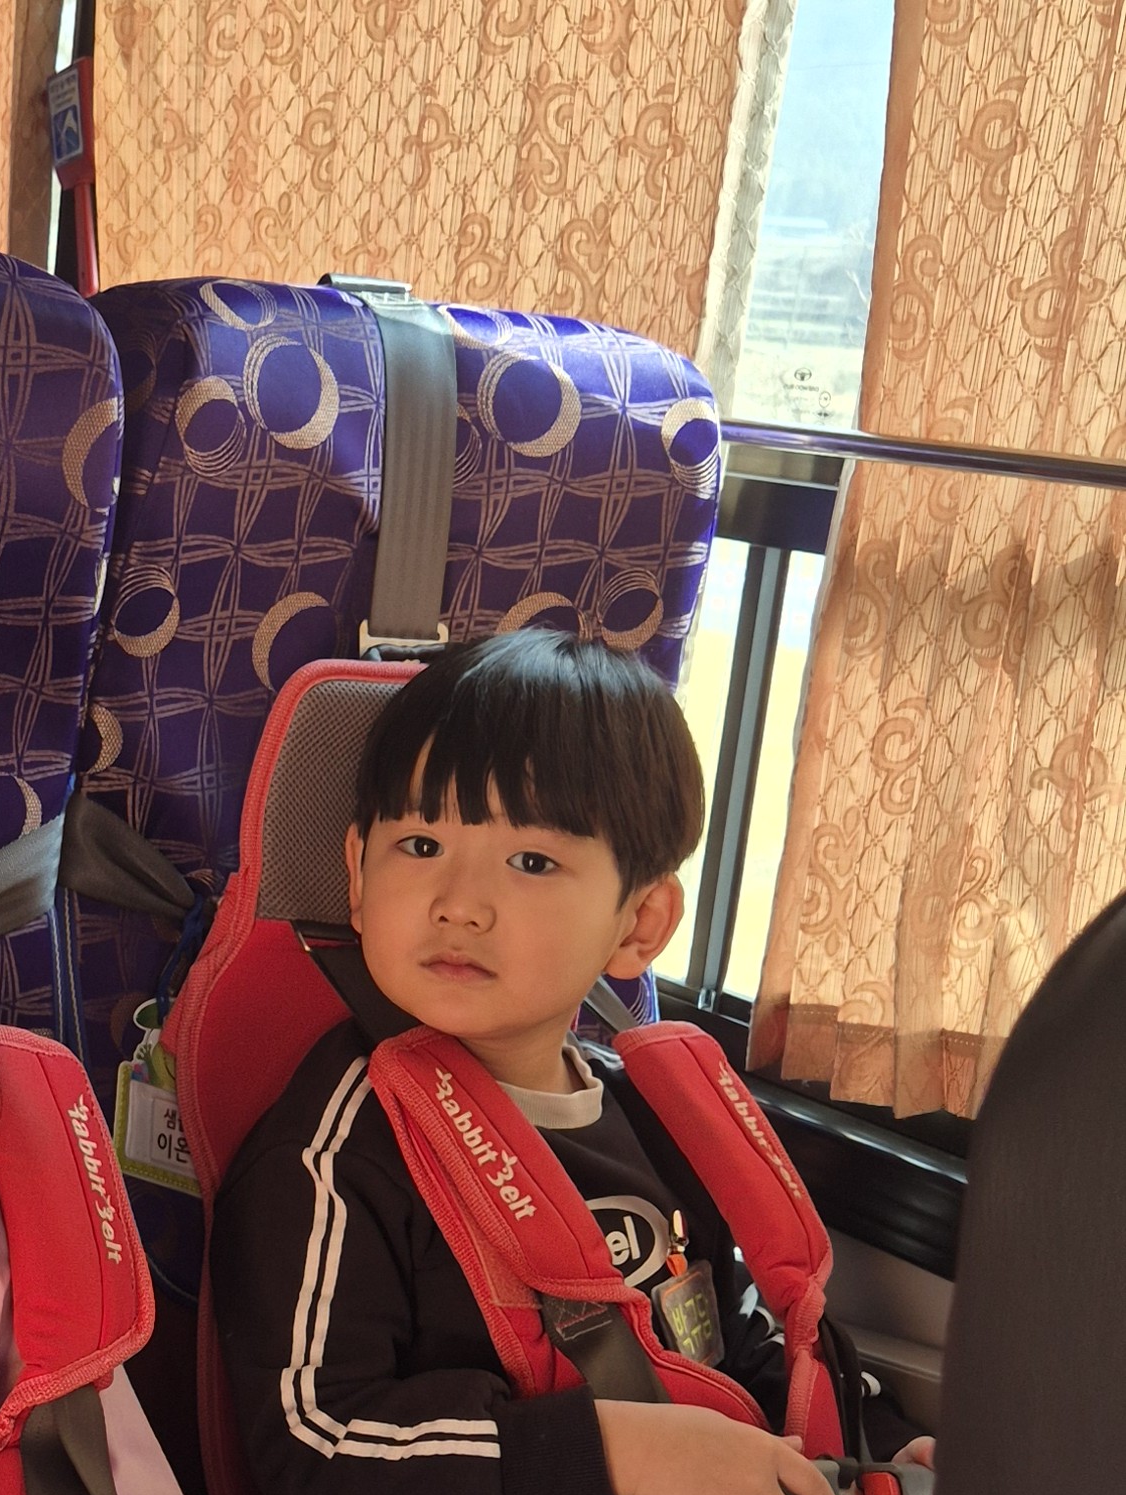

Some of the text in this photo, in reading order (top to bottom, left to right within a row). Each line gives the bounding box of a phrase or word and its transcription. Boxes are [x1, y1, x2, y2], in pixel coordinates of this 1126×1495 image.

[67, 1093, 123, 1265] Rabbit Belt
[435, 1067, 538, 1221] Rabbit Belt
